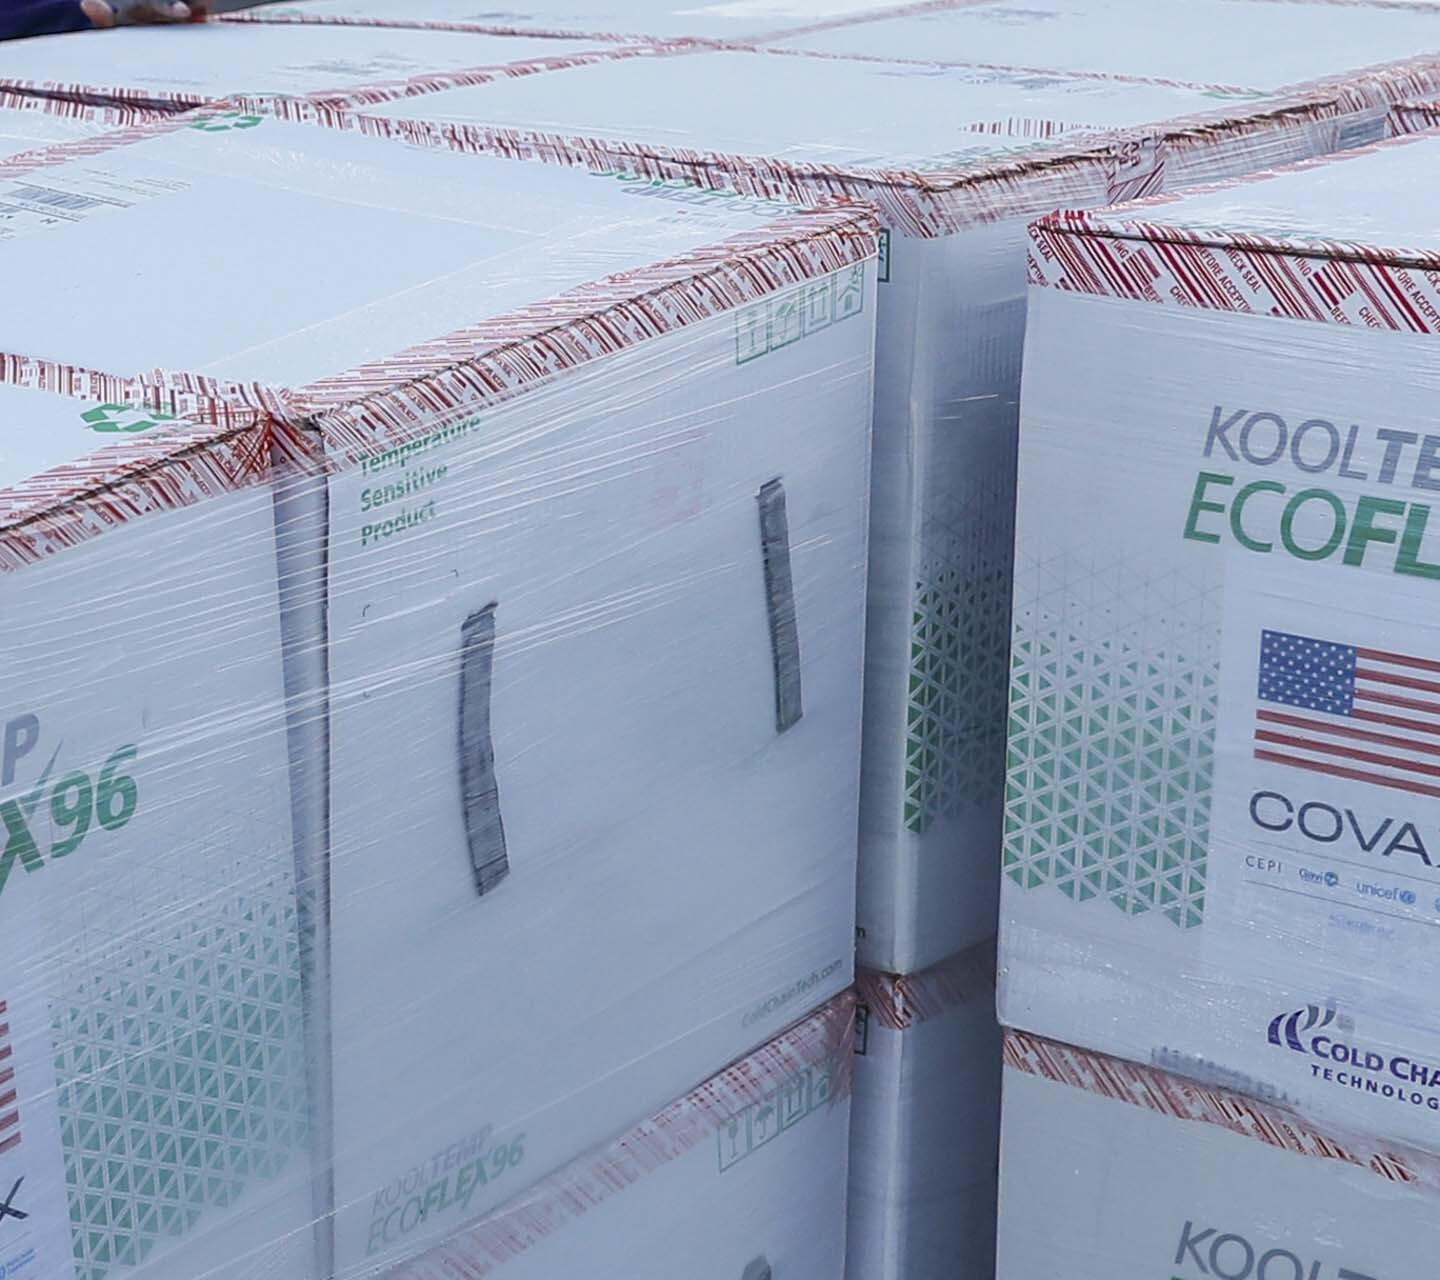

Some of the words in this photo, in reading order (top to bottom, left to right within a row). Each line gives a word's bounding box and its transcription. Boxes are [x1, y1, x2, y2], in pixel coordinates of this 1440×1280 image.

[359, 463, 449, 513] Sensitive
[360, 498, 438, 548] Product
[1244, 855, 1283, 875] CEPI
[1356, 880, 1400, 903] unicef
[1311, 1035, 1385, 1072] COLD
